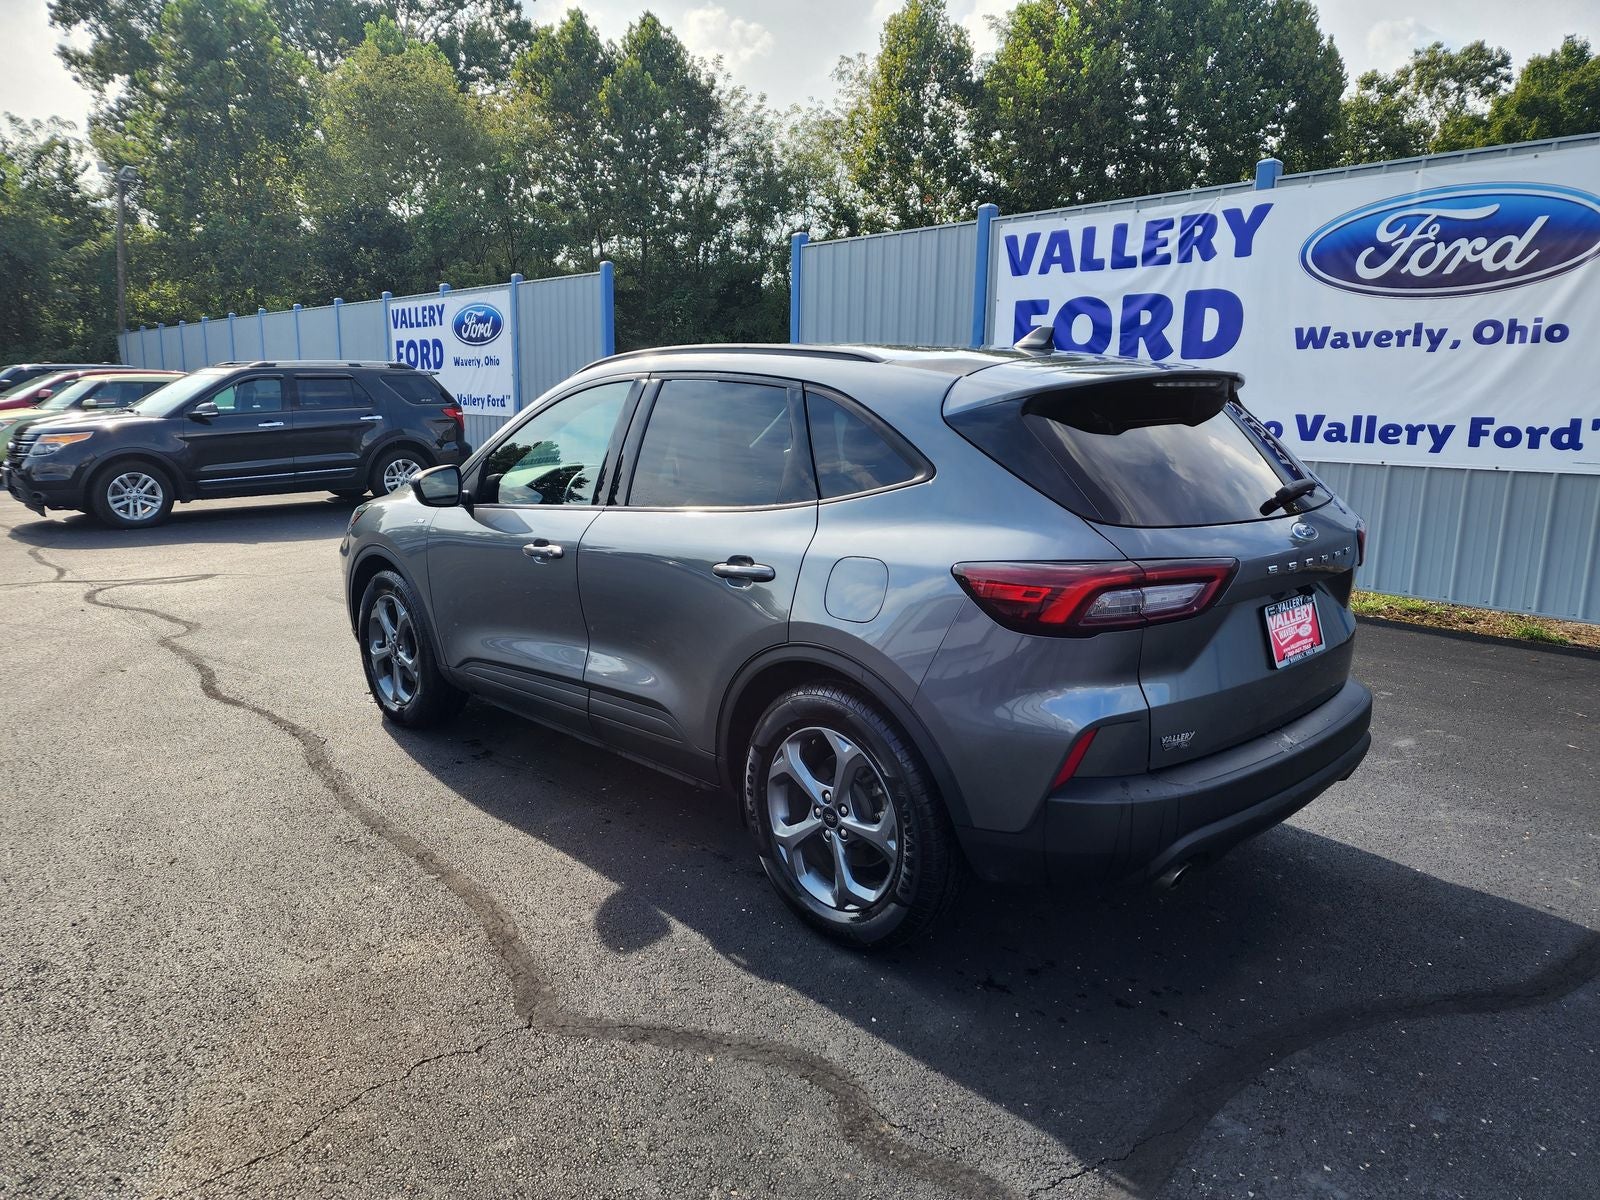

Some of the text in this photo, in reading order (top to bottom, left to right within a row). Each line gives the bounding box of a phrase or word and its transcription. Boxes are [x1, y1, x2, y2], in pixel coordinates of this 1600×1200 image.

[1004, 203, 1274, 277] VALLERY
[1355, 203, 1550, 280] Ford
[391, 303, 446, 330] VALLERY
[461, 310, 494, 339] Ford
[1012, 288, 1244, 361] FORD
[1294, 316, 1570, 353] Waverly, Ohio
[396, 338, 444, 370] FORD
[453, 355, 500, 369] Waverly, Ohio
[456, 393, 486, 410] Vallery
[1295, 413, 1456, 453] Vallery
[1269, 603, 1313, 630] VALLERY
[1277, 596, 1304, 613] VALLERY
[1161, 730, 1195, 743] VALLERY
